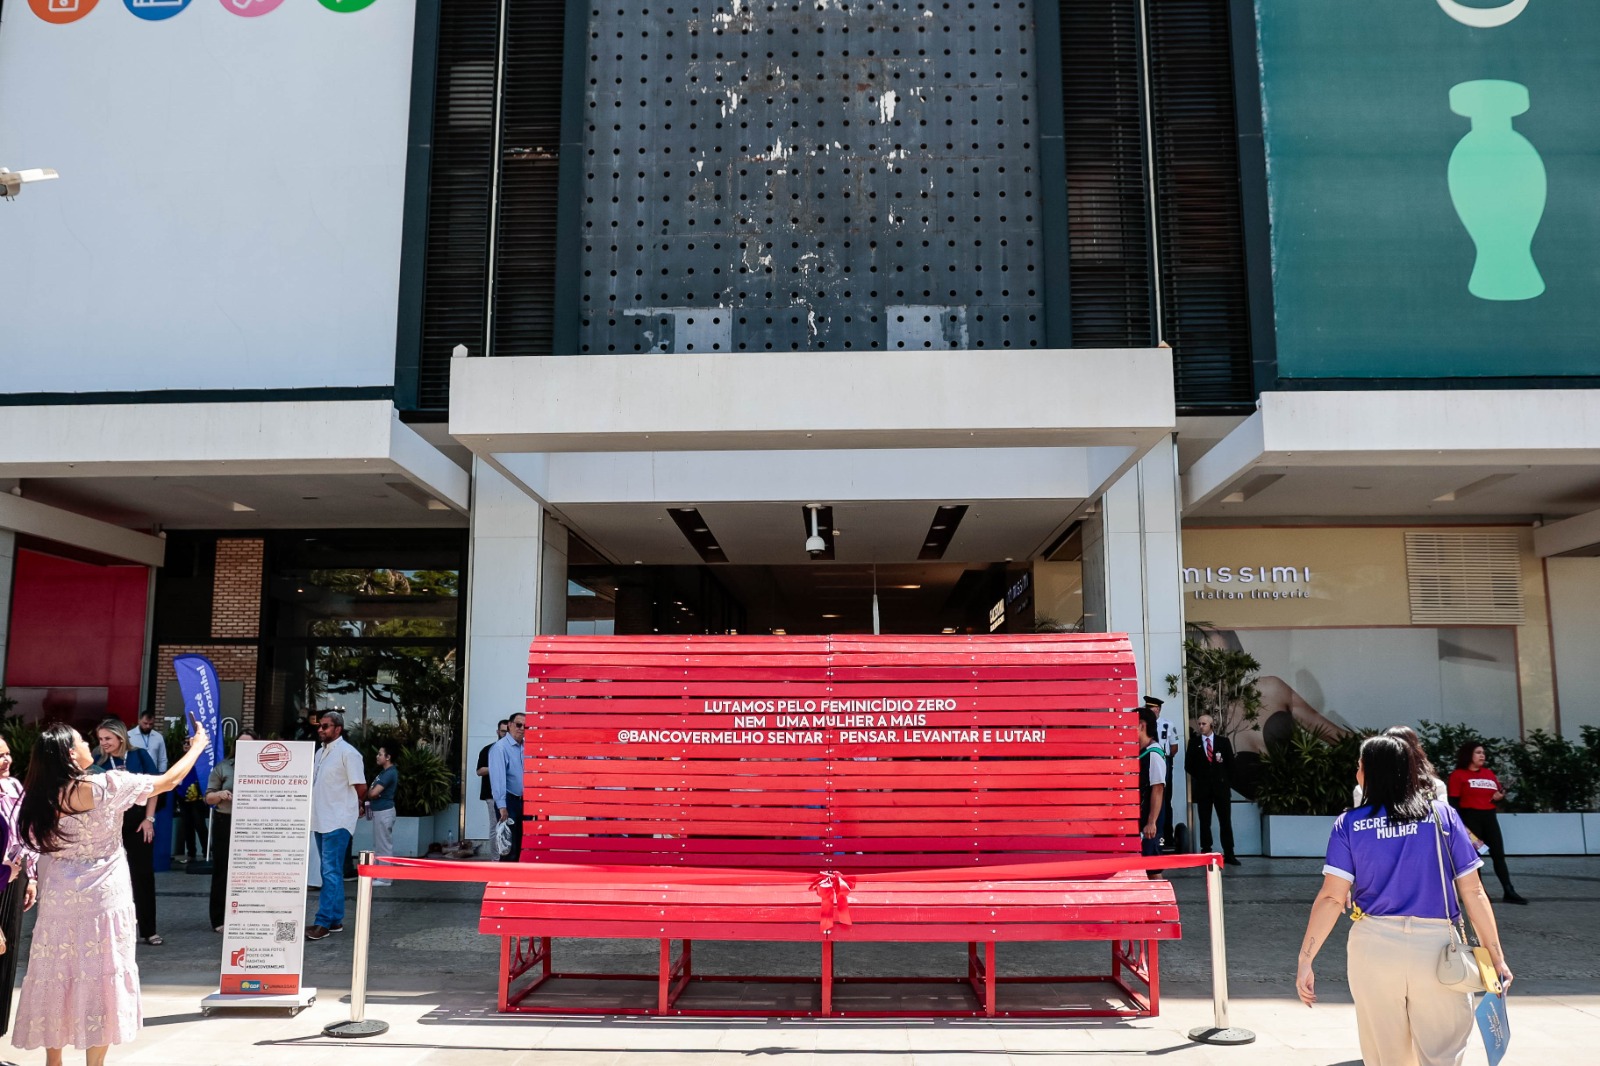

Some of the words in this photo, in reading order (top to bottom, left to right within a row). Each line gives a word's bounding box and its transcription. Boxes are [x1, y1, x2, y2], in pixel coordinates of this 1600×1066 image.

[1194, 590, 1244, 599] Italian
[1250, 589, 1310, 601] lingerie
[704, 700, 775, 713] LUTAMOS
[777, 700, 817, 713] PELO
[820, 697, 914, 713] FEMINICÍDIO
[916, 698, 957, 712] ZERO
[734, 715, 766, 728] NEM
[776, 715, 810, 728] UMA
[812, 715, 874, 727] MULHER
[876, 715, 888, 727] A
[890, 714, 927, 727] MAIS
[617, 729, 764, 744] @BANCOVERMELHO
[767, 731, 823, 744] SENTAR
[840, 730, 900, 743] PENSAR.
[904, 730, 979, 743] LEVANTAR
[983, 730, 992, 743] E
[995, 730, 1046, 743] LUTAR!
[238, 777, 286, 785] FEMINICÍDIO
[1376, 823, 1418, 839] MULHER
